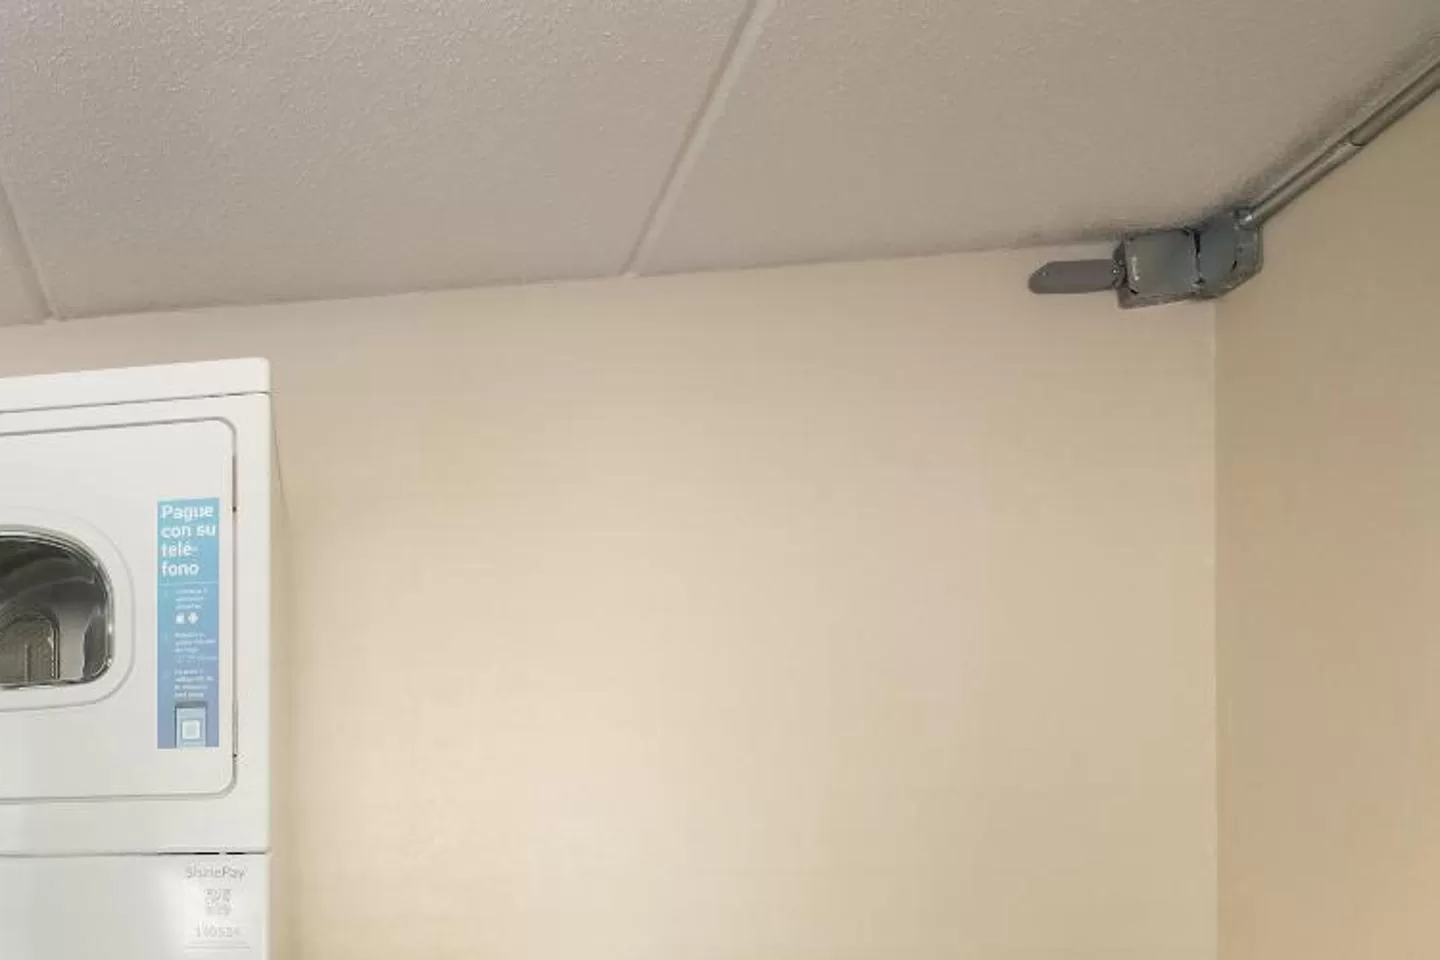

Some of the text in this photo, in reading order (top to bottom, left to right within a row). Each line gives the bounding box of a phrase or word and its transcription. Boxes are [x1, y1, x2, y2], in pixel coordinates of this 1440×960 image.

[161, 505, 214, 523] Pague
[160, 524, 216, 538] con su
[161, 540, 199, 557] telé-
[161, 560, 200, 577] fono
